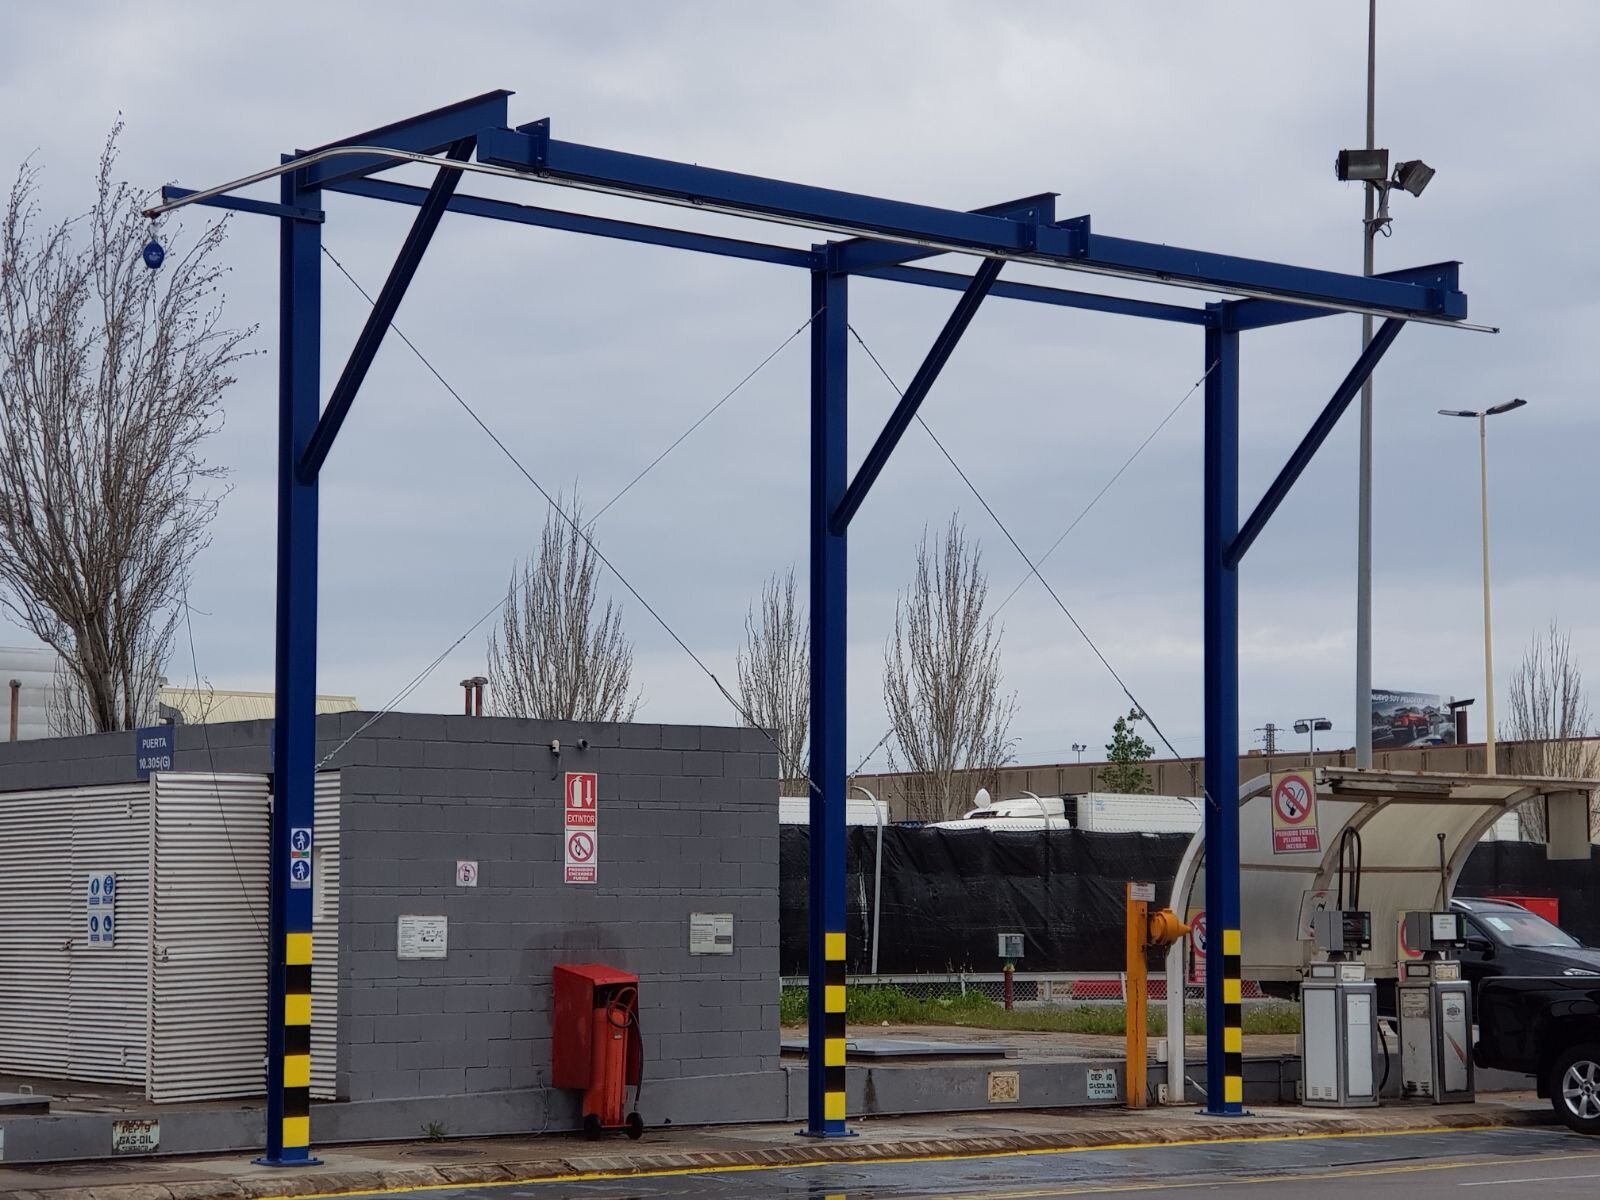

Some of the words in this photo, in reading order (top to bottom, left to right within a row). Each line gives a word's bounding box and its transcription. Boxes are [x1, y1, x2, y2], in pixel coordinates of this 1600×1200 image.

[142, 737, 167, 749] PUERTA
[139, 755, 170, 770] 10.305(G)
[567, 814, 595, 823] EXTINTOR
[119, 1134, 154, 1145] GAS-OIL
